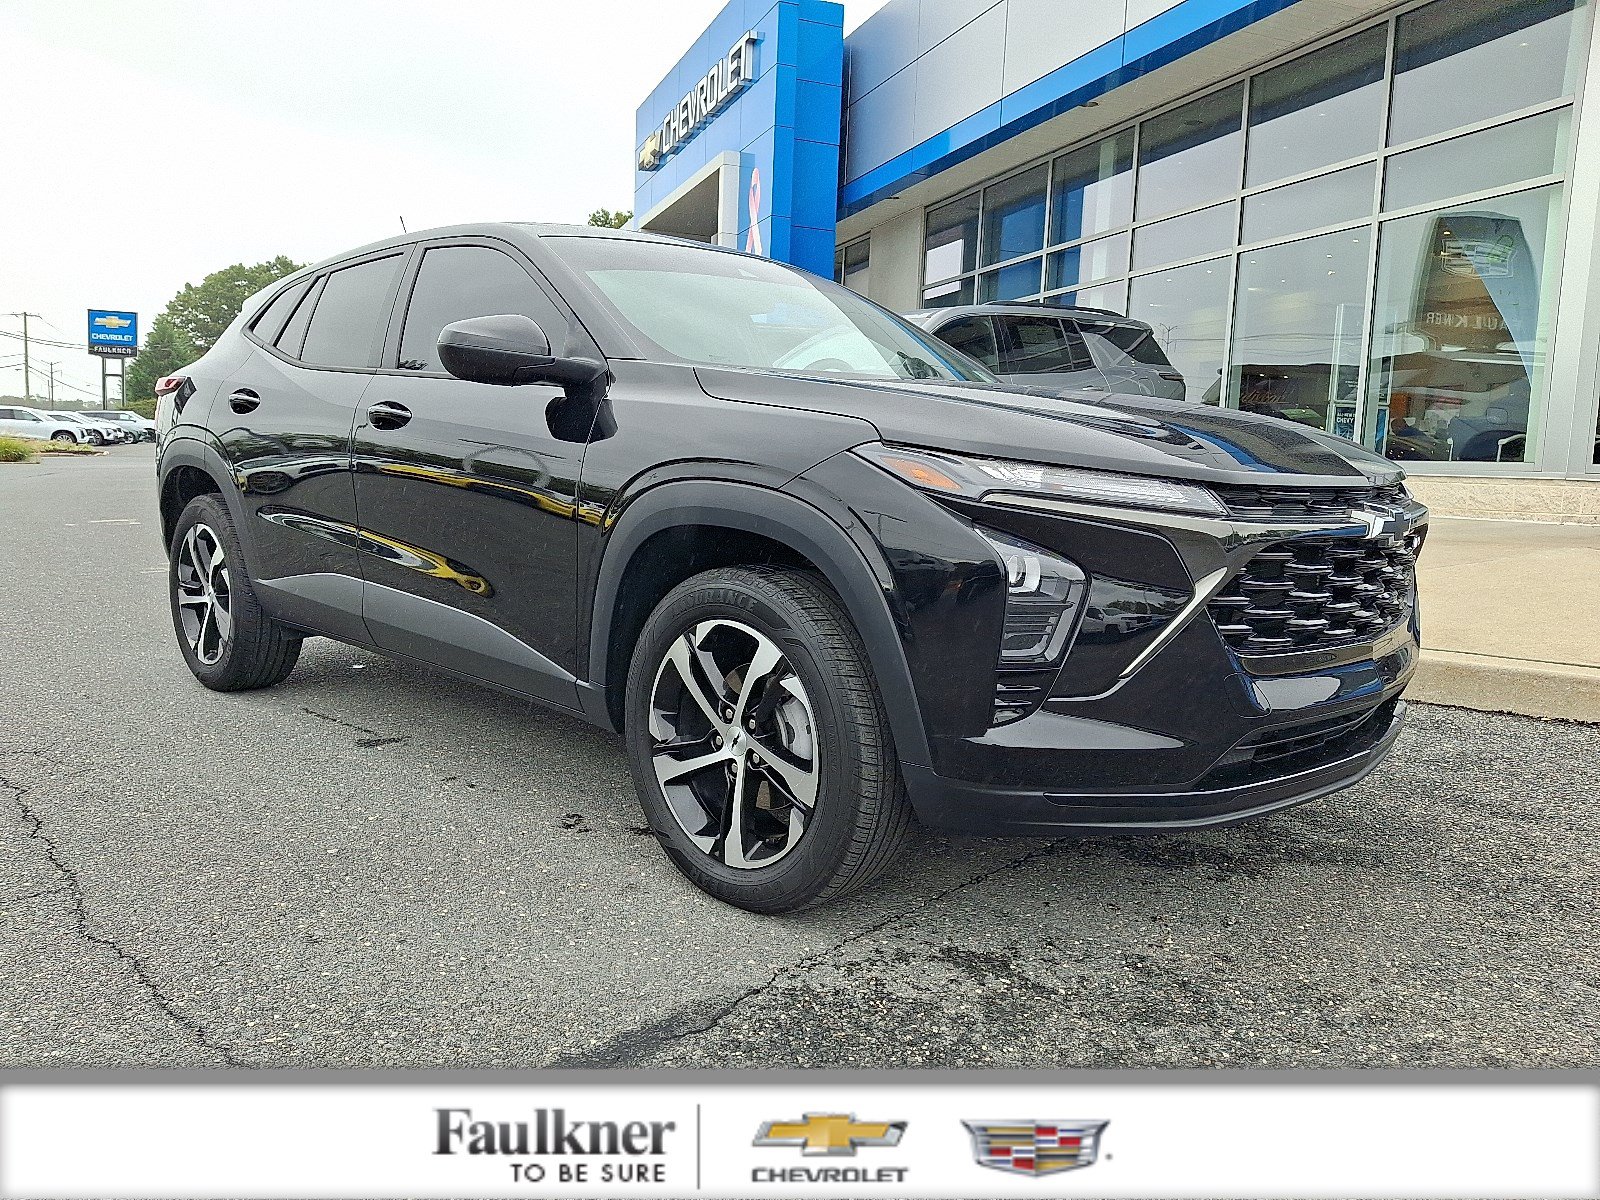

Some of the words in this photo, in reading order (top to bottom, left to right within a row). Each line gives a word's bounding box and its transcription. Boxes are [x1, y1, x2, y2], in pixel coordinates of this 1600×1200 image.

[661, 30, 758, 151] CHEVROLET
[91, 333, 133, 341] CHEVROLET
[94, 345, 131, 354] FAULKNER
